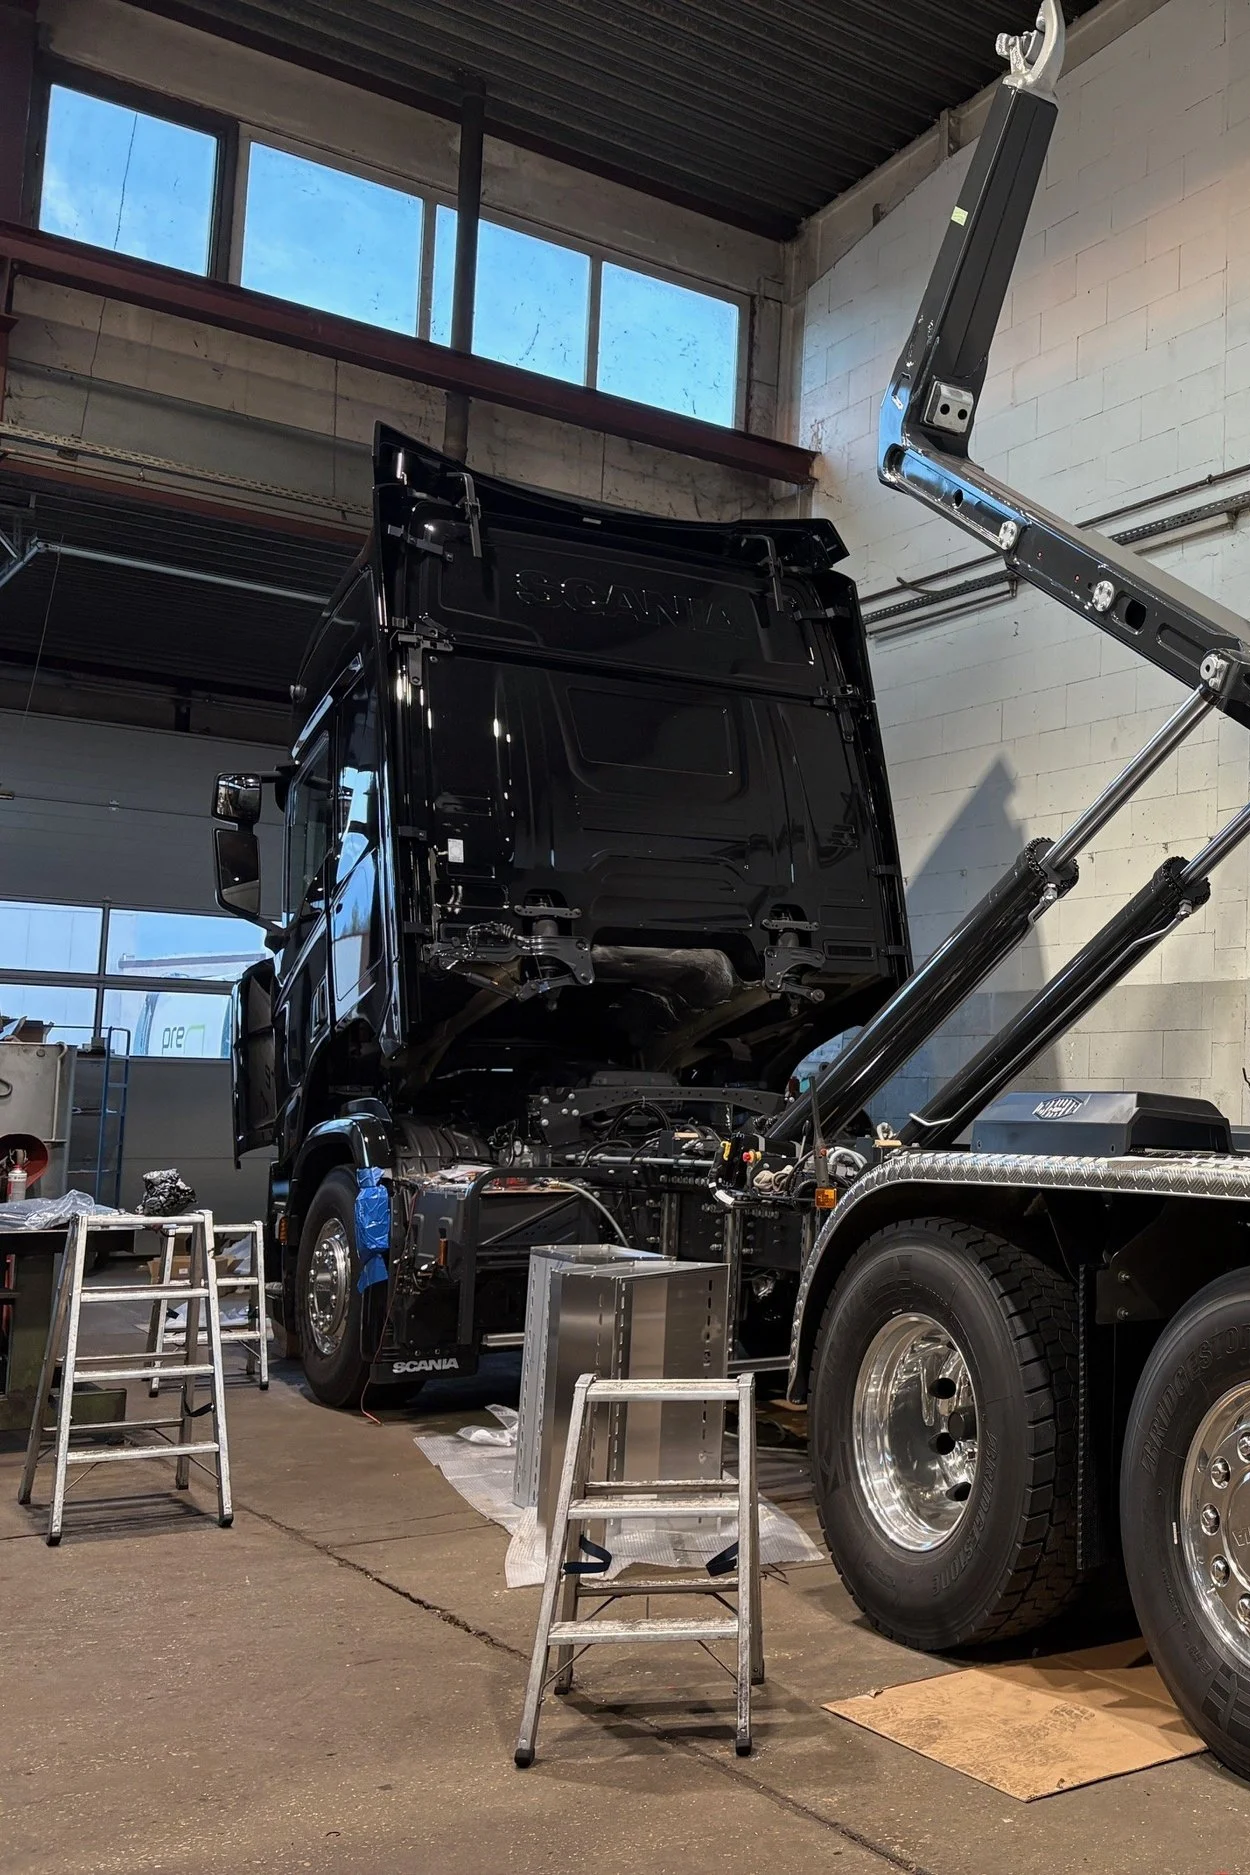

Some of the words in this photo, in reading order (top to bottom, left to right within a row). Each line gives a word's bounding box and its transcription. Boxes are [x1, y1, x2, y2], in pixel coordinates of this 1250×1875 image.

[515, 568, 747, 638] SCANIA
[392, 1357, 459, 1374] SCANIA
[931, 1431, 1000, 1597] BRIDGESTONE
